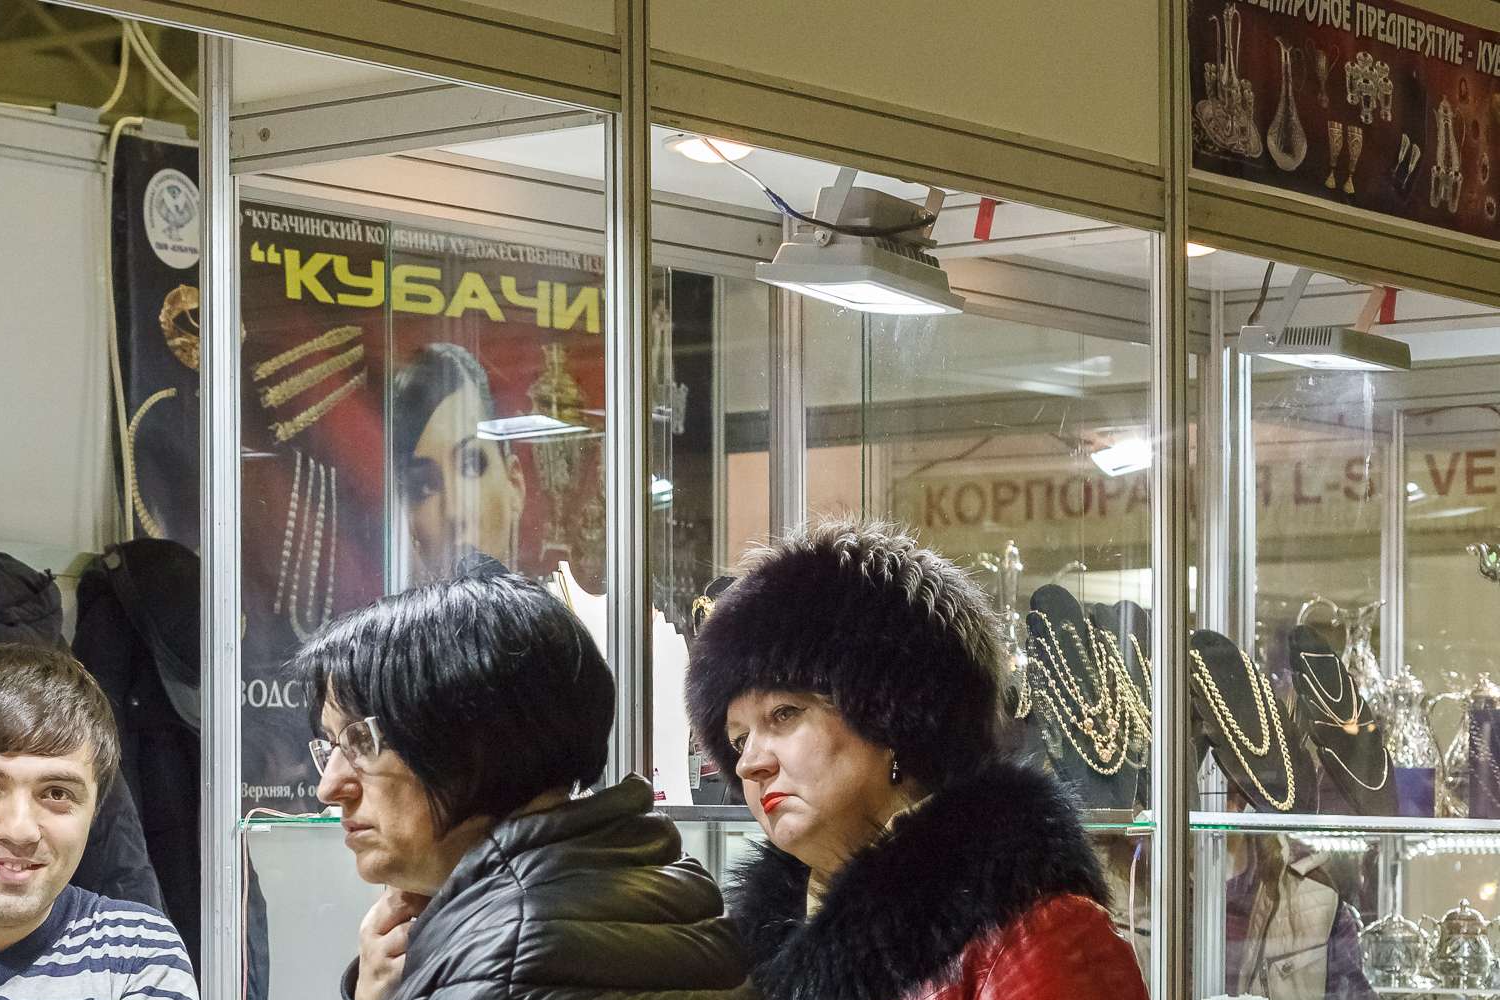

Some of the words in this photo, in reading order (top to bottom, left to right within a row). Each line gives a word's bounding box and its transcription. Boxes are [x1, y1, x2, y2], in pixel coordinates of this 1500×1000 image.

[1355, 4, 1465, 65] ПРЕДПЕРЯТИЕ
[583, 255, 602, 275] ИЗ
[250, 241, 605, 334] “КУБАЧИ
[241, 782, 294, 802] Верхняя,
[297, 782, 305, 797] 6
[308, 785, 318, 797] о
